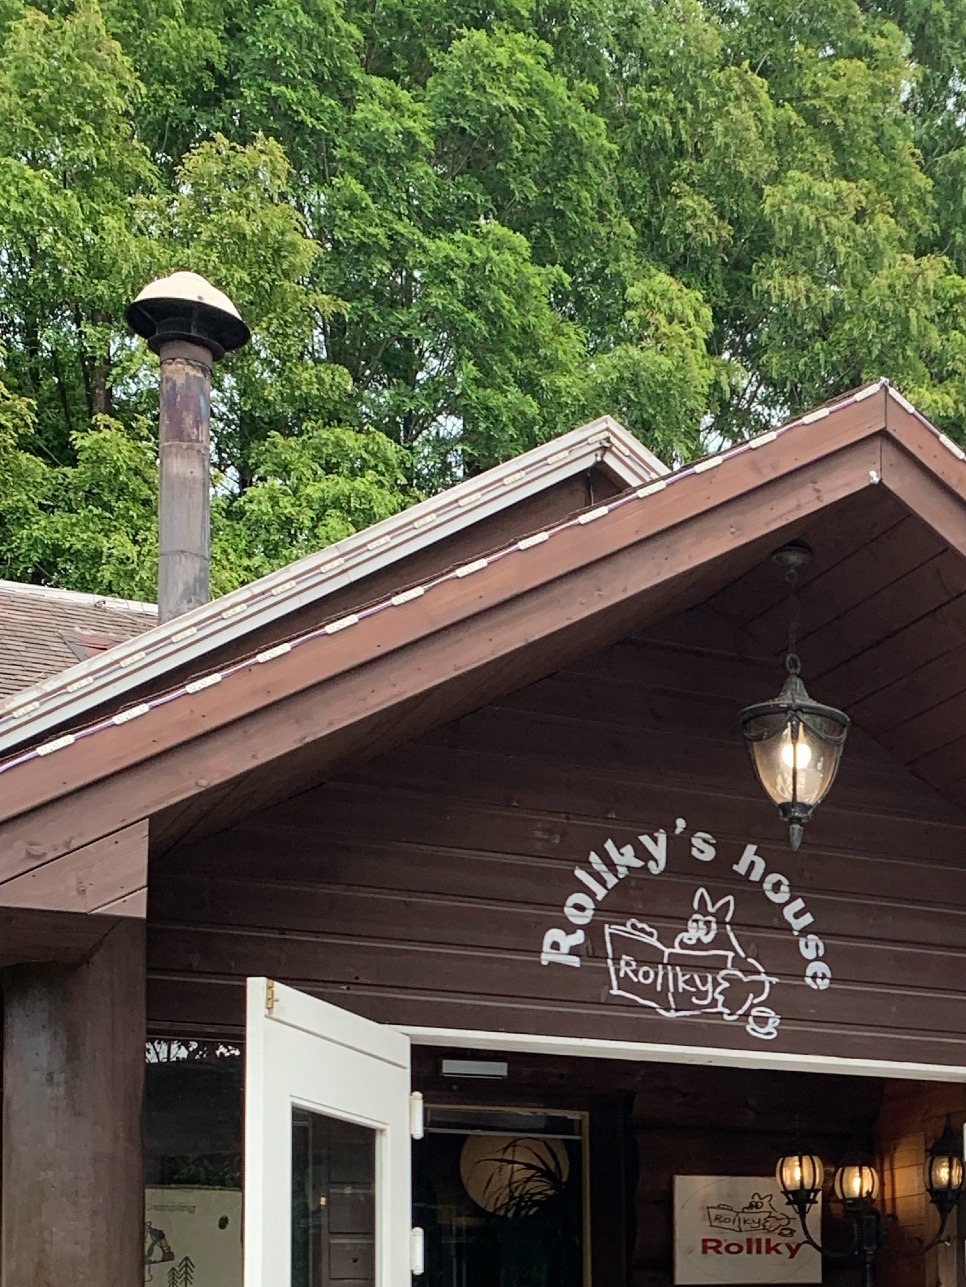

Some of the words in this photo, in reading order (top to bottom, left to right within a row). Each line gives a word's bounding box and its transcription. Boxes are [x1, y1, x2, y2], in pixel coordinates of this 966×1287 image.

[541, 817, 717, 968] Rollky's
[732, 844, 832, 990] house
[701, 1237, 801, 1259] Rollky
